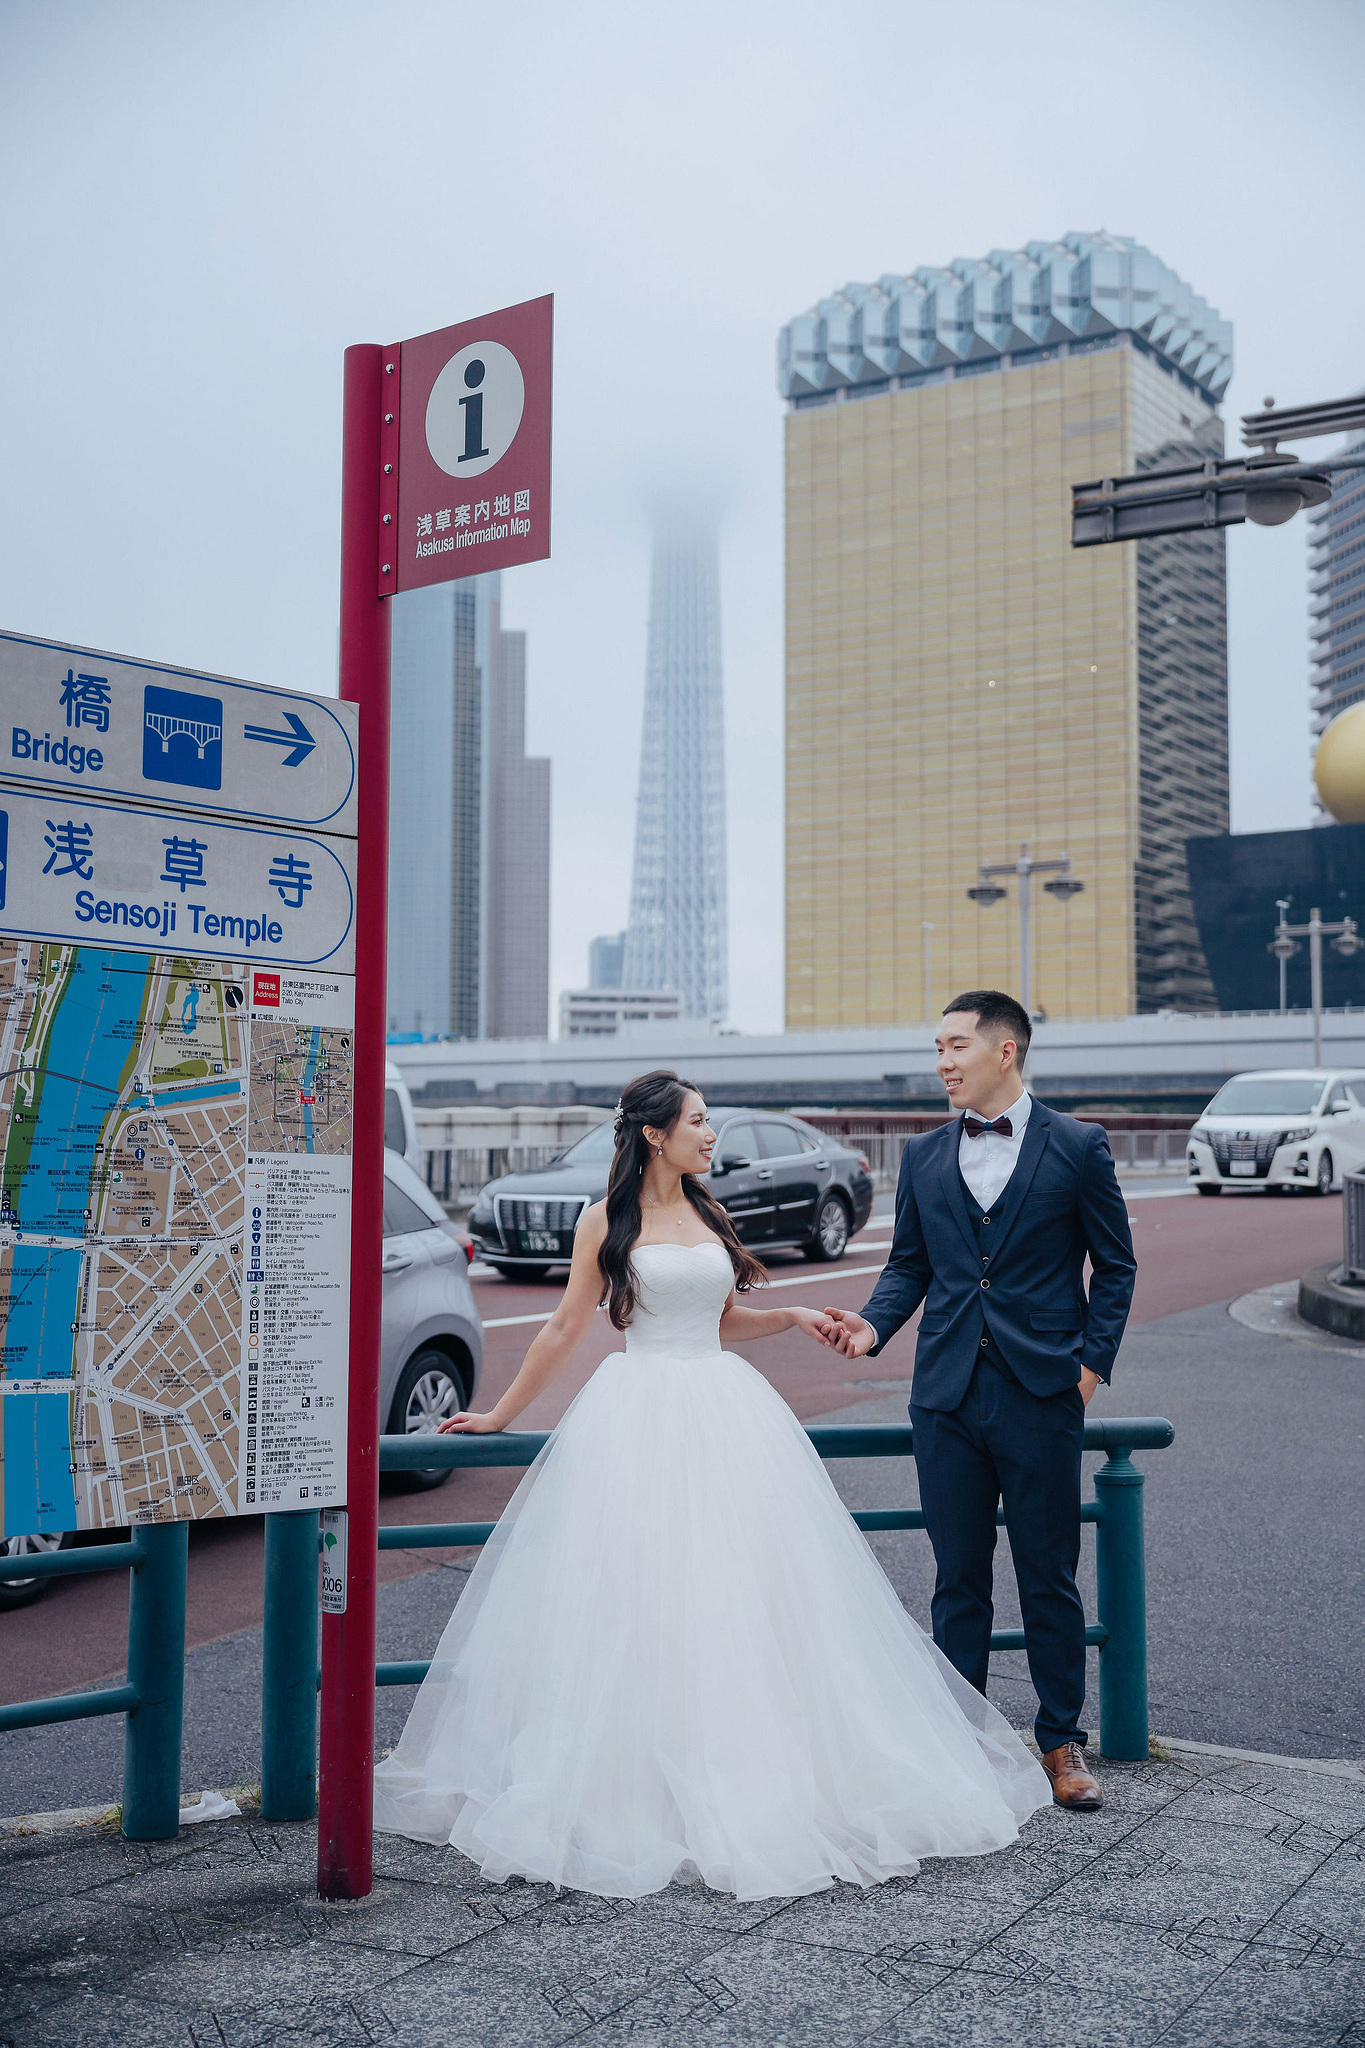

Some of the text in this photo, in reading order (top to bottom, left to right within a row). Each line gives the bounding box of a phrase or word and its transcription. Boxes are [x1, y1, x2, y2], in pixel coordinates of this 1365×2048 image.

[416, 488, 530, 538] 浅草案内地図
[415, 517, 531, 558] Asakusa Information Map
[59, 669, 111, 732] 橋
[12, 727, 104, 774] Bridge
[42, 820, 312, 908] 浅草寺
[75, 890, 283, 947] Sensoji Temple
[255, 990, 279, 999] Address
[257, 981, 276, 990] 現在地
[164, 1486, 210, 1498] Sumida City
[176, 1474, 199, 1486] 墨田区
